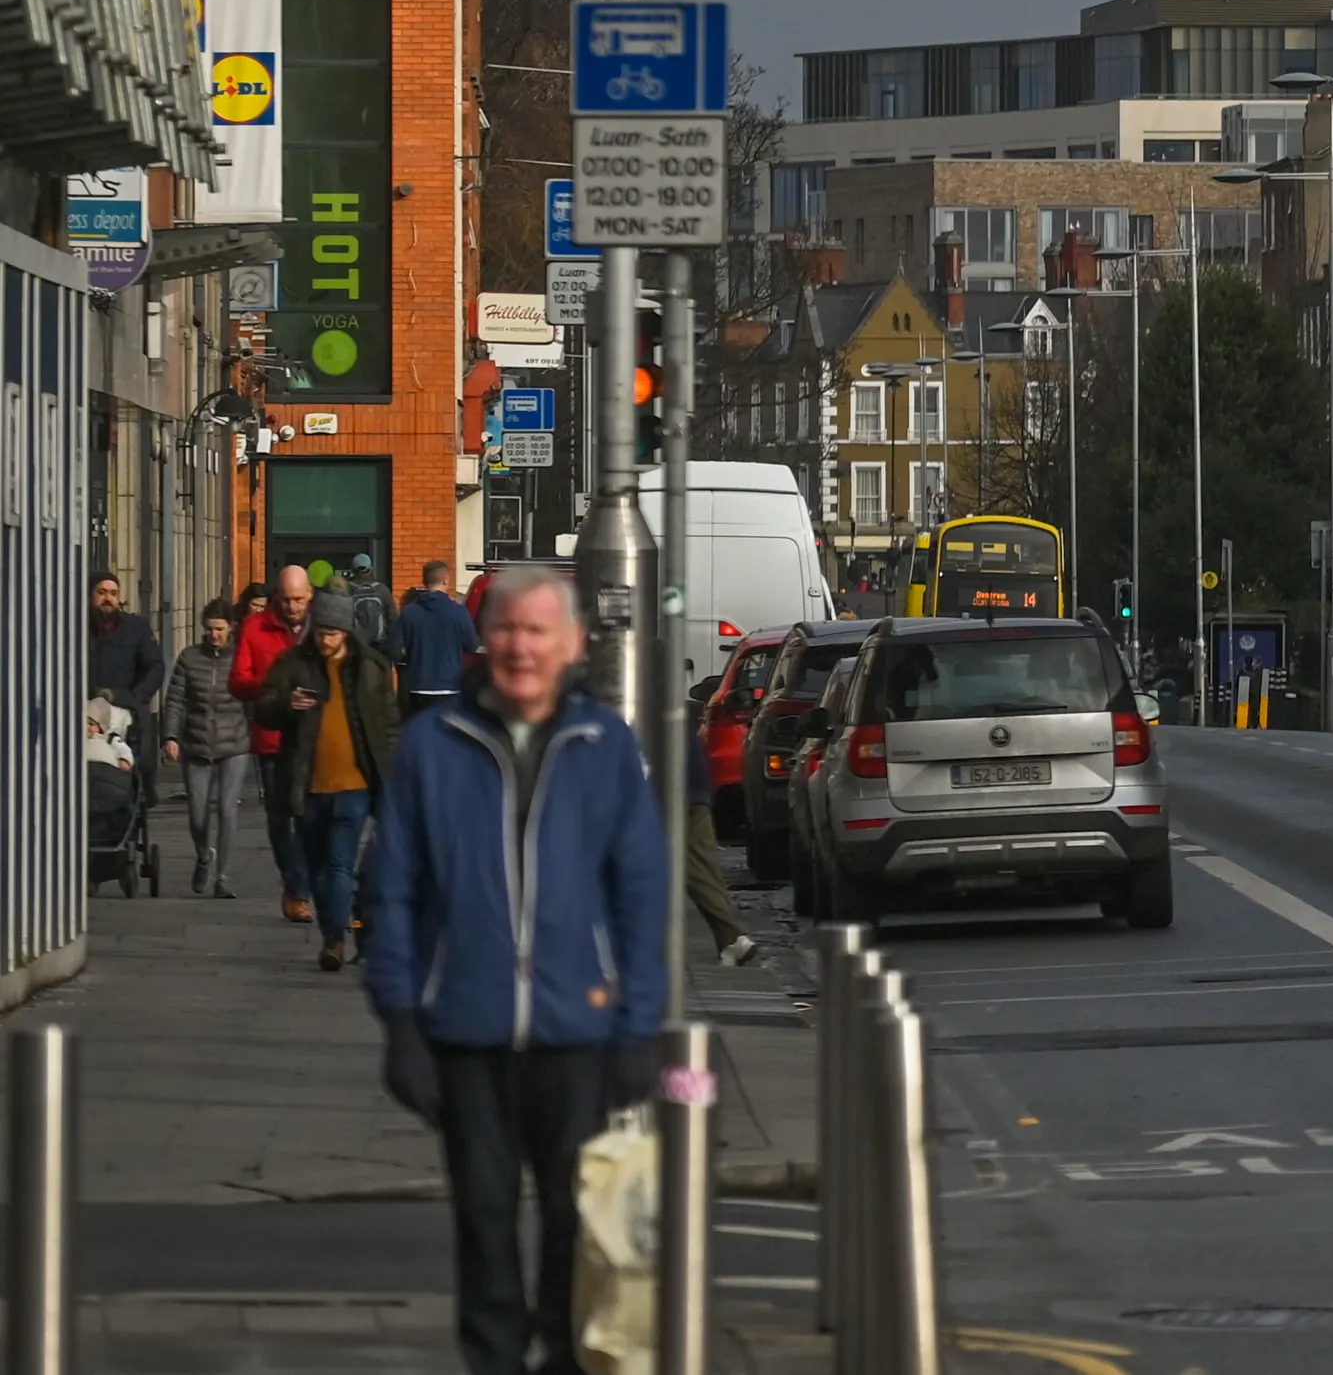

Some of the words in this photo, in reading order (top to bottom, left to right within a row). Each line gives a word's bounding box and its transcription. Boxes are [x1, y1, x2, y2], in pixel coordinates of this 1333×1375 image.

[93, 208, 136, 235] depot
[312, 193, 359, 300] HOT
[312, 314, 359, 329] YOGA
[1024, 592, 1036, 607] 14
